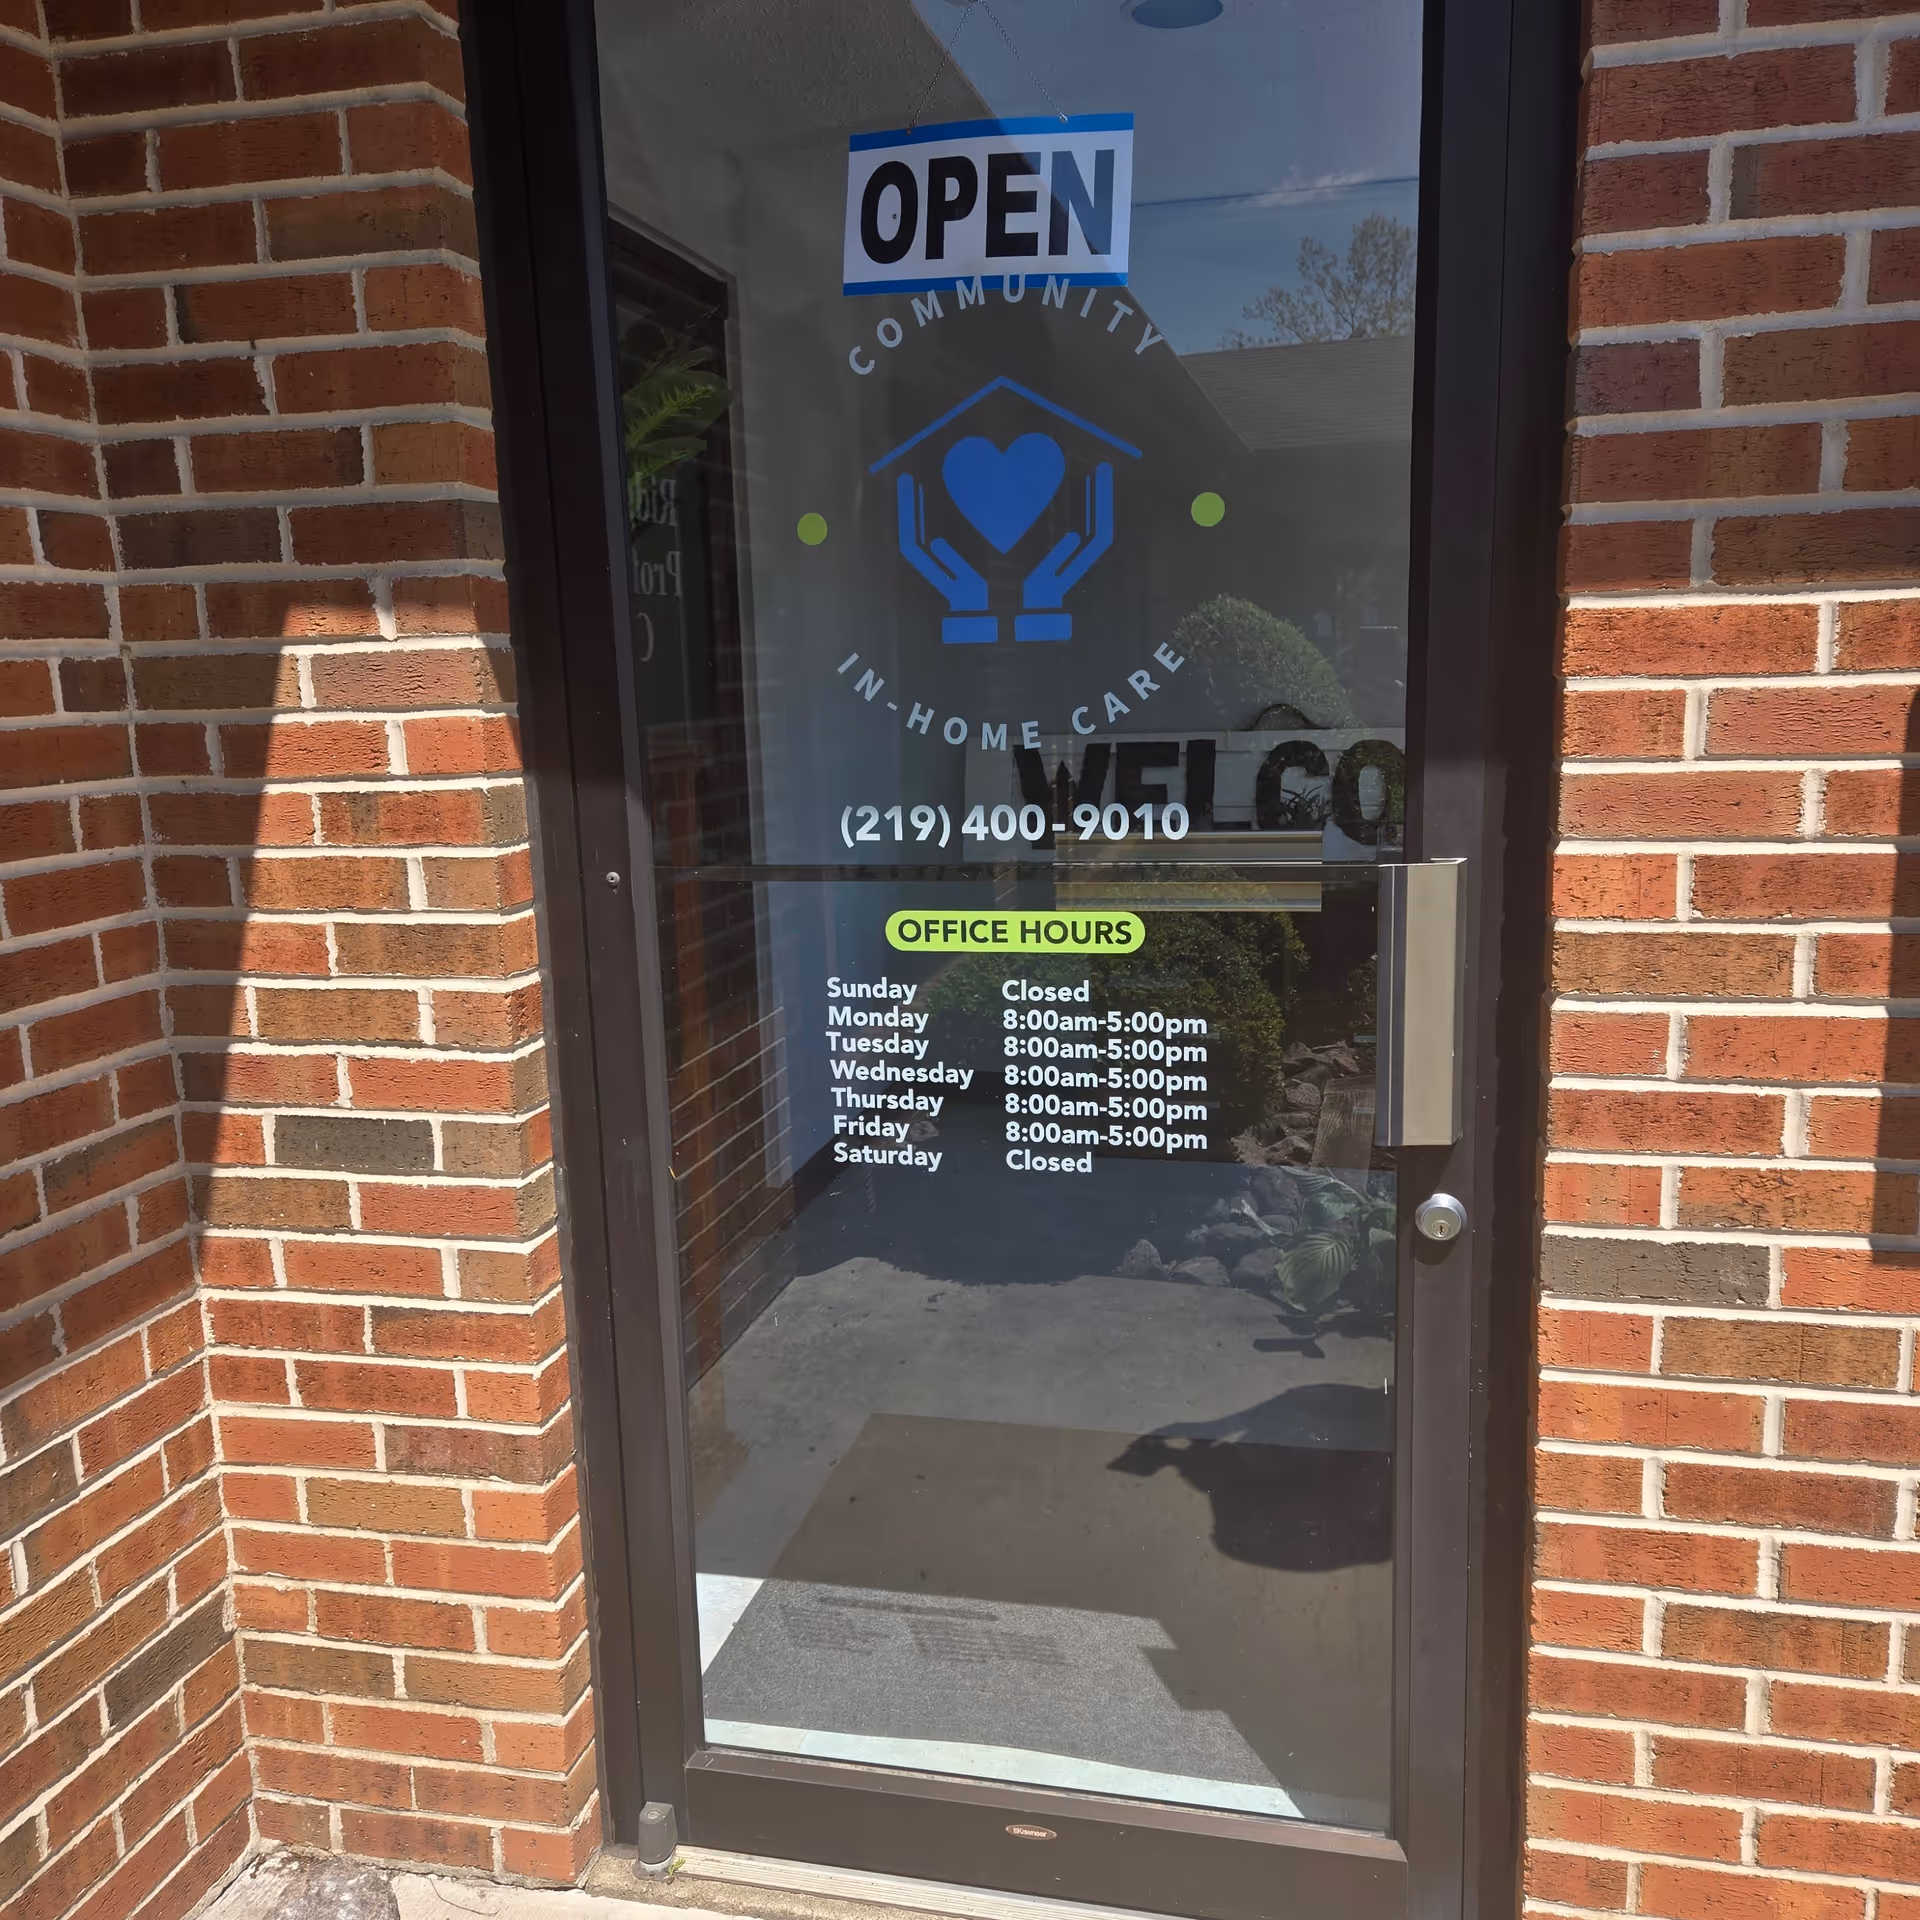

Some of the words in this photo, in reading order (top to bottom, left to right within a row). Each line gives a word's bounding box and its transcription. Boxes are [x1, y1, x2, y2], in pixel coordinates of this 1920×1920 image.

[859, 148, 1116, 265] OPEN
[848, 273, 1165, 376] COMMUNITY
[836, 652, 1042, 751] IN-HOME
[1070, 641, 1185, 735] CARE
[840, 806, 951, 848] (219)
[961, 802, 1190, 842] 400-9010
[897, 919, 1009, 944] OFFICE
[1020, 920, 1133, 945] HOURS
[826, 976, 918, 1005] Sunday
[1001, 979, 1090, 1002] Closed
[828, 1005, 930, 1033] Monday
[1003, 1008, 1207, 1039] 8:00am-5:00pm
[825, 1031, 930, 1060] Tuesday
[1003, 1036, 1207, 1067] 8:00am-5:00pm
[830, 1059, 974, 1089] Wednesday
[1004, 1064, 1207, 1096] 8:00am-5:00pm
[830, 1086, 944, 1116] Thursday
[1005, 1092, 1207, 1125] 8:00am-5:00pm
[833, 1114, 910, 1143] Friday
[1005, 1121, 1208, 1154] 8:00am-5:00pm
[833, 1142, 943, 1171] Saturday
[1005, 1148, 1092, 1173] Closed
